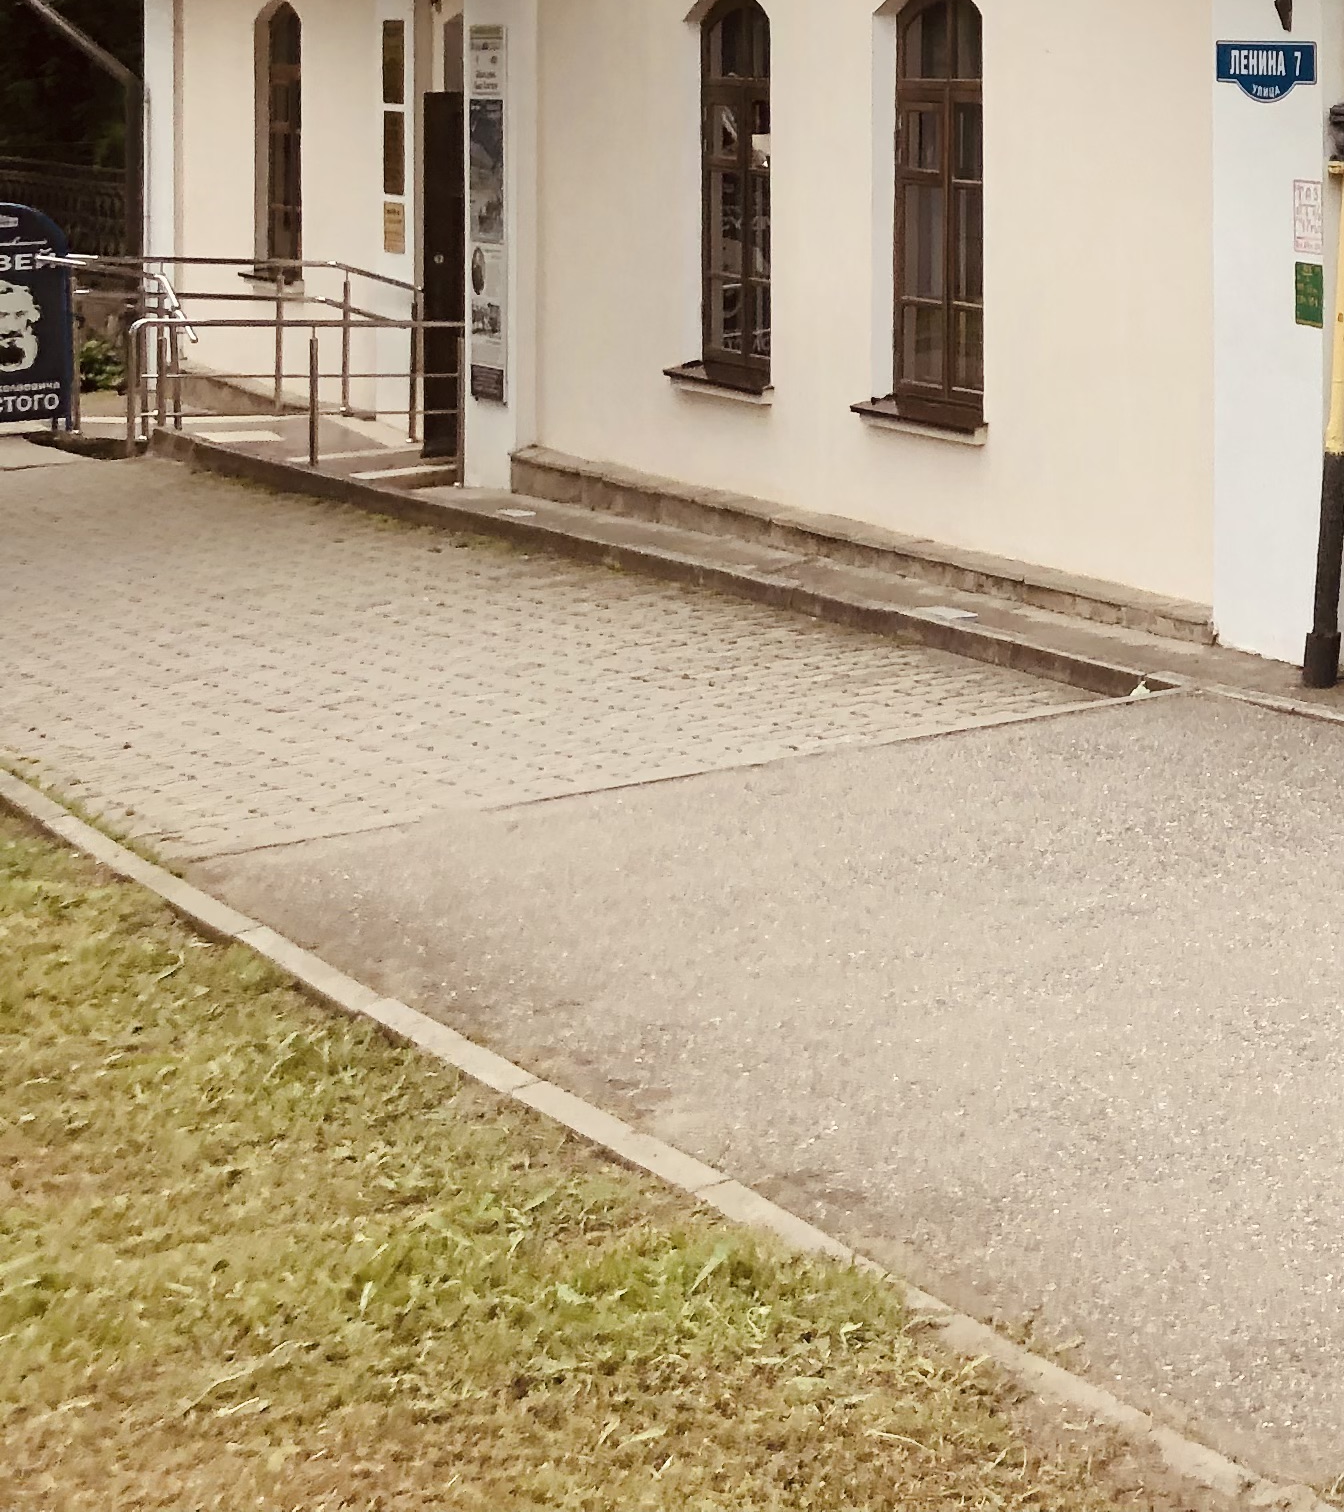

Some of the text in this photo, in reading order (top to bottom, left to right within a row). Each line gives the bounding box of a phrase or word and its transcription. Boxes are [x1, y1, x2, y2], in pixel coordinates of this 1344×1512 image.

[1229, 49, 1302, 76] ЛЕНИНА 7
[1252, 83, 1281, 98] УЛИЦА
[0, 393, 60, 412] ТОГО
